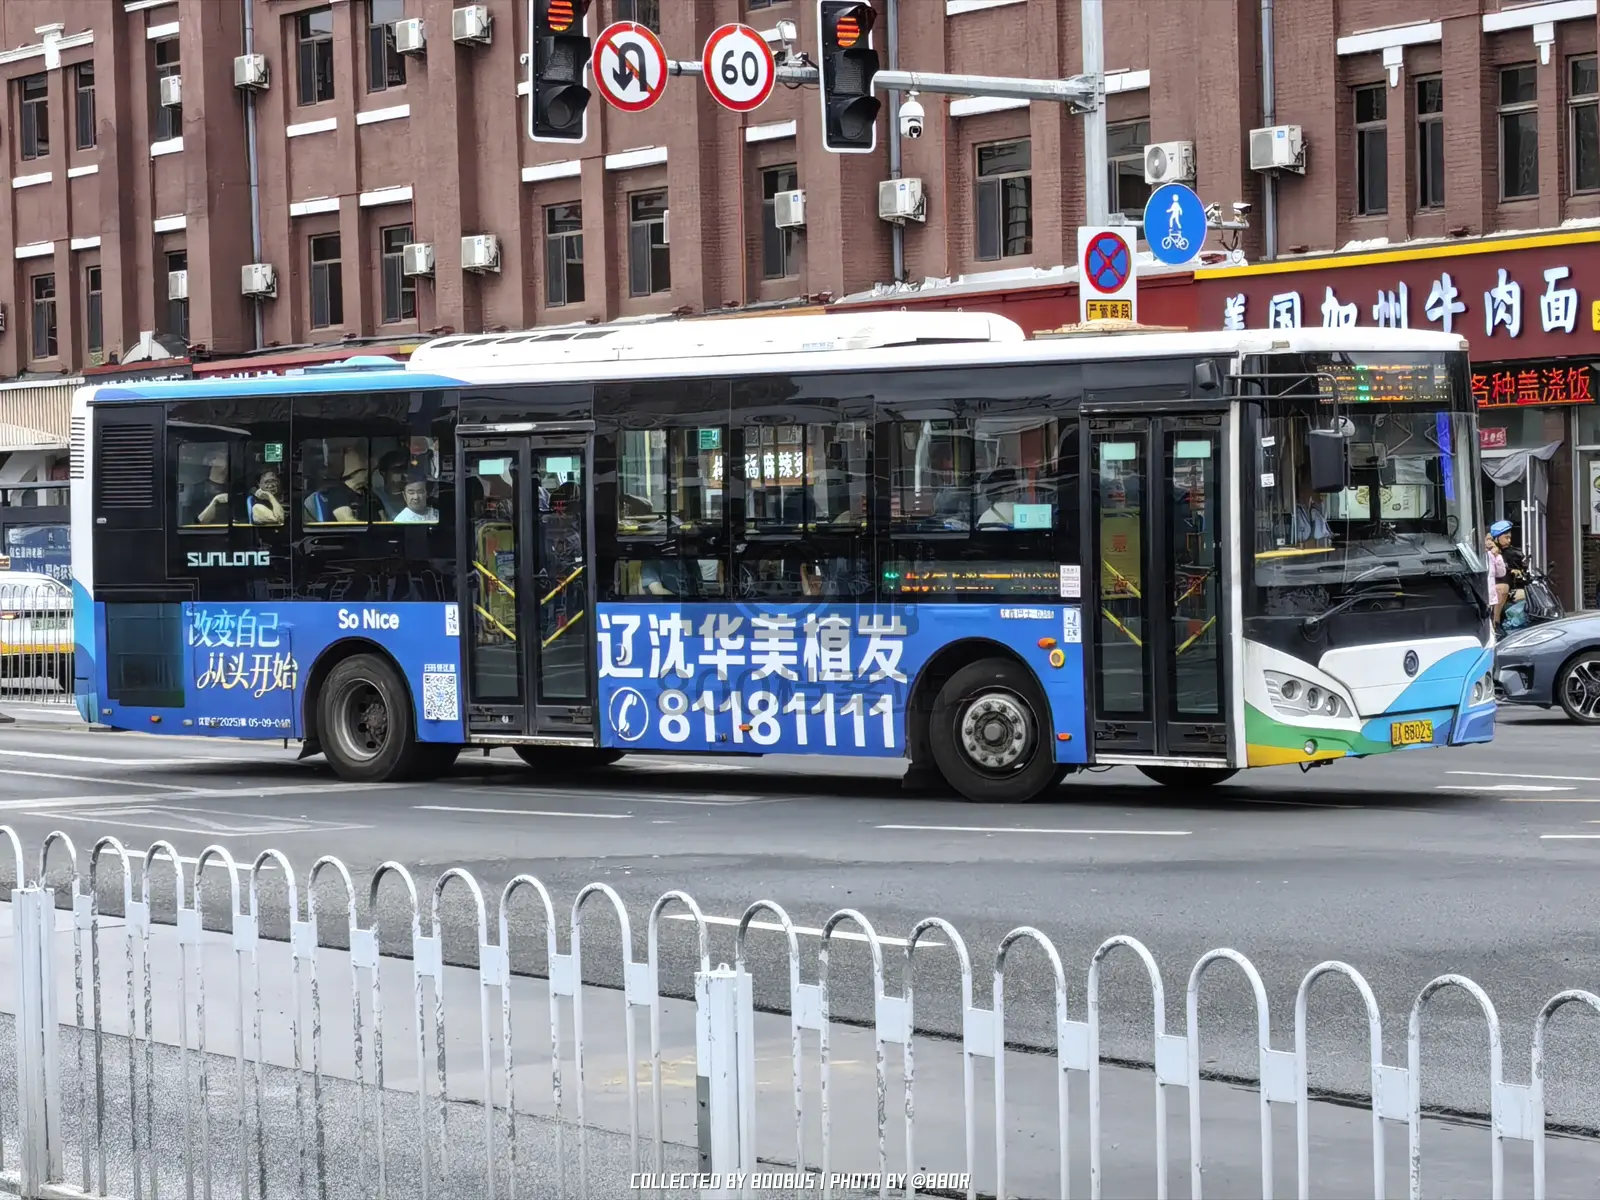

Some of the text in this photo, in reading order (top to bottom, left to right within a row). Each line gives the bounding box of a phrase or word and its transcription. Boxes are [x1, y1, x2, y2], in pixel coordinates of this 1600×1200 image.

[721, 49, 759, 87] 60
[1223, 266, 1579, 338] 美国加州牛肉面
[1471, 366, 1592, 407] 各种盖浇饭
[186, 551, 270, 567] SUNLONG
[186, 608, 280, 648] 改变自己
[338, 608, 399, 630] So Nice
[597, 612, 908, 684] 辽沈华美植发
[196, 651, 298, 698] 从头开始
[657, 688, 896, 748] 81181111
